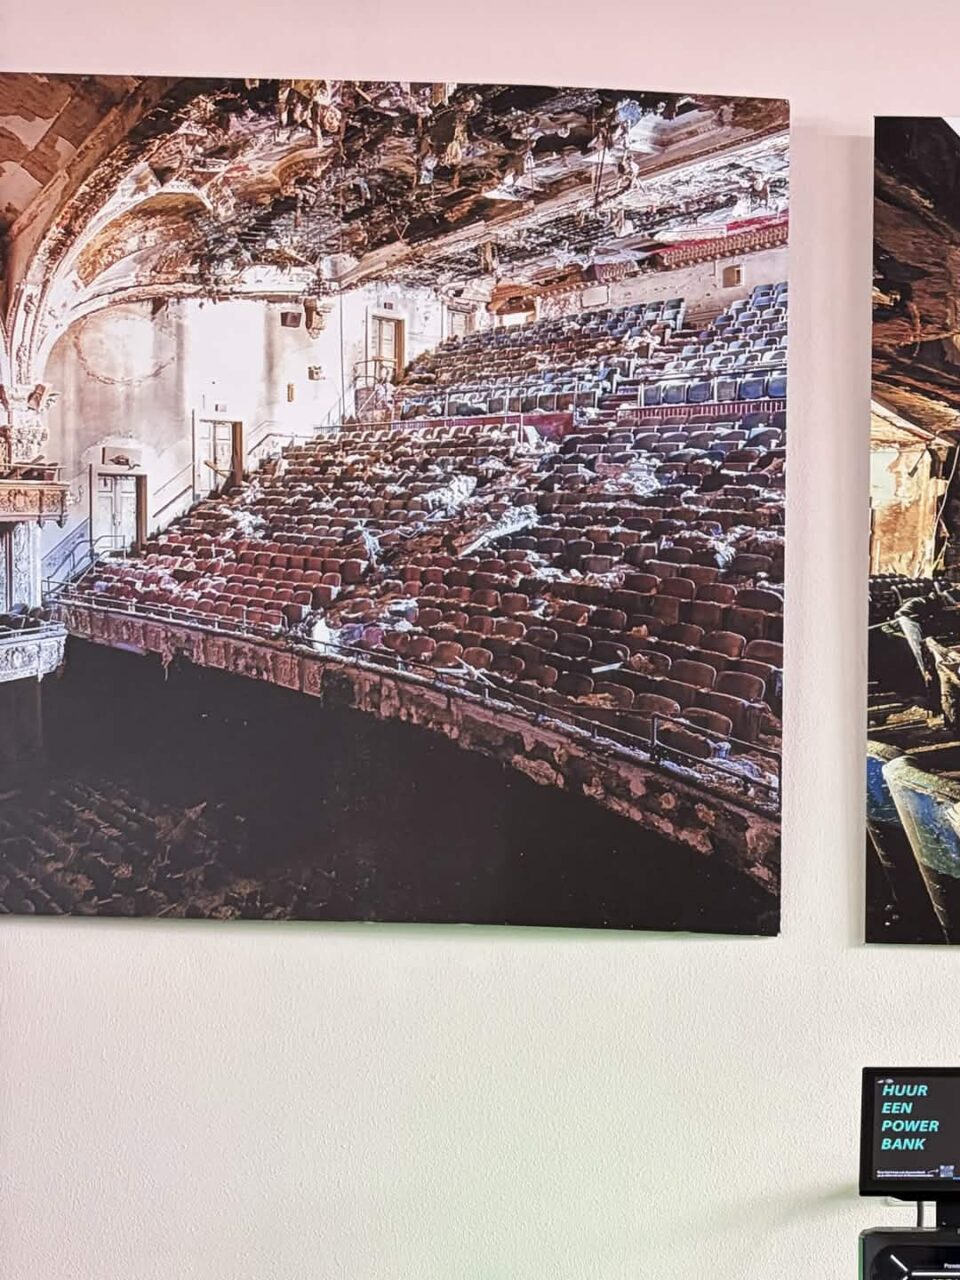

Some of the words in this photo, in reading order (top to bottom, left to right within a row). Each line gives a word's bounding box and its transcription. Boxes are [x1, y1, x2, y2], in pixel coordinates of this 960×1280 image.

[882, 1084, 928, 1096] HUUR
[881, 1102, 913, 1114] EEN
[881, 1120, 940, 1132] POWER
[881, 1138, 926, 1150] BANK
